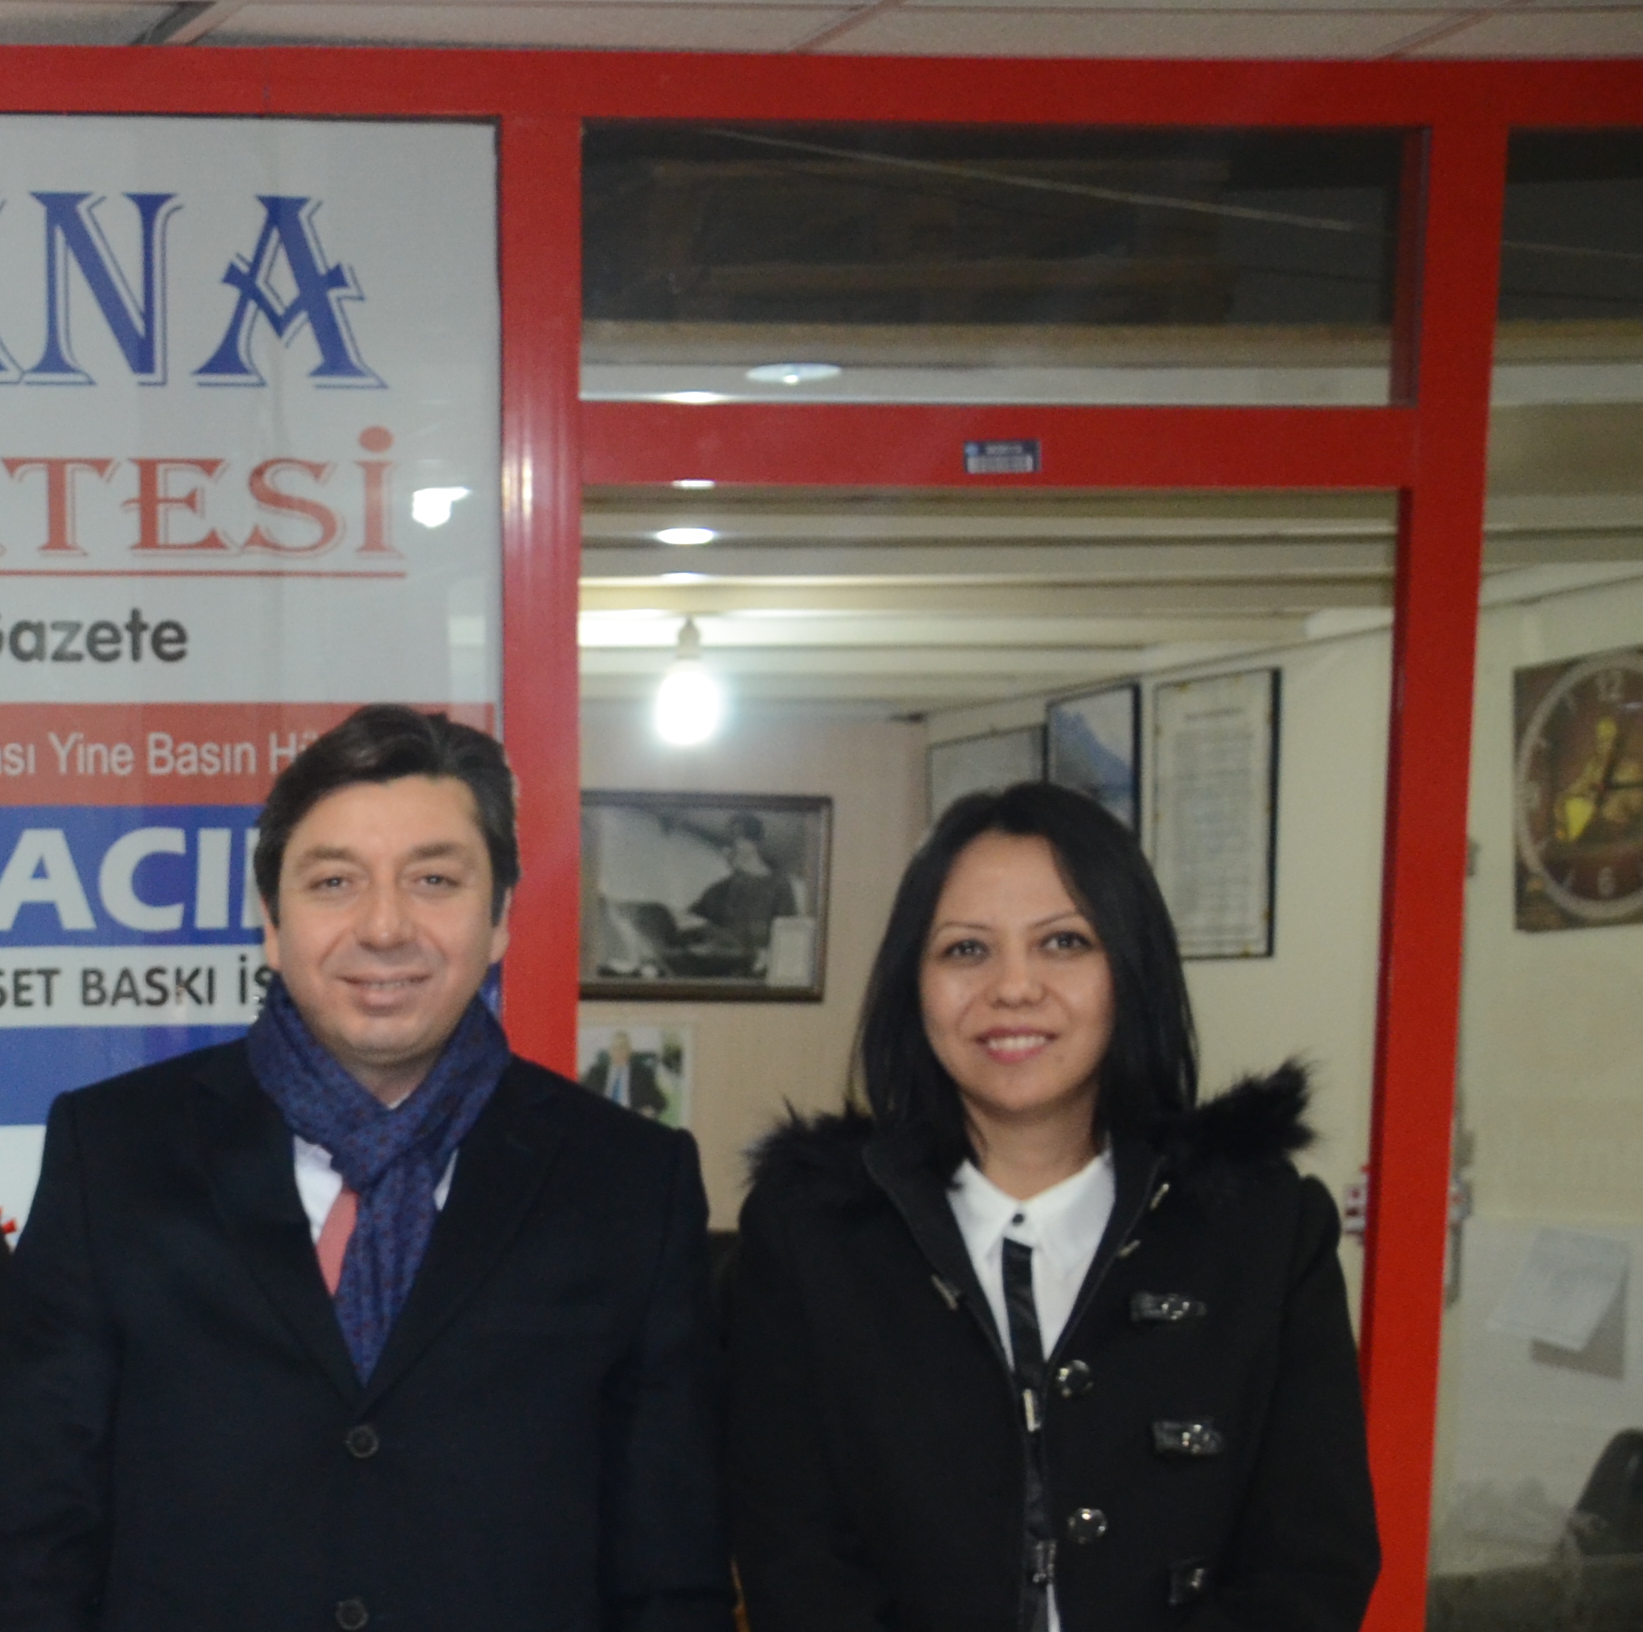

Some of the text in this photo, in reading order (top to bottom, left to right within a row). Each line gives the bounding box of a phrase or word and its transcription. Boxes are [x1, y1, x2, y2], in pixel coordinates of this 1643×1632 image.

[47, 731, 136, 776] Yine
[145, 732, 258, 776] Basın
[83, 964, 215, 1007] BASKI
